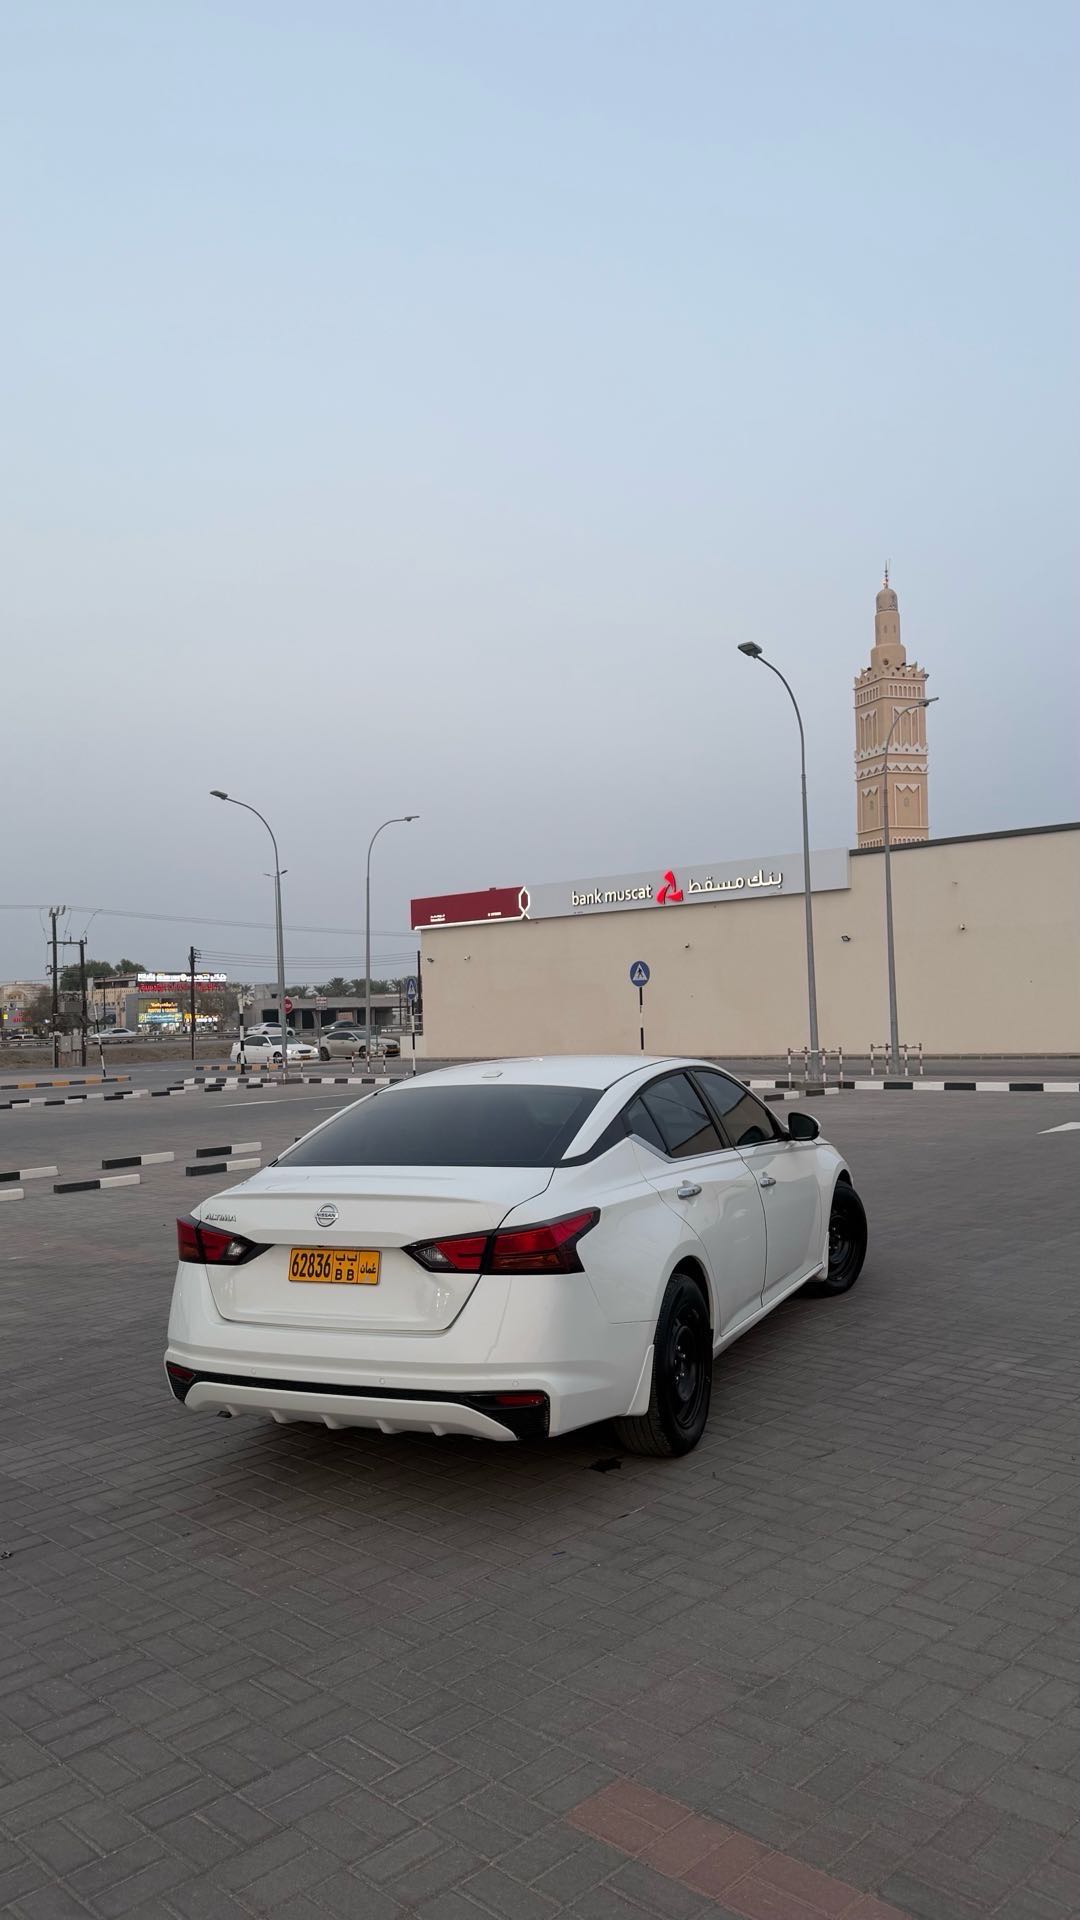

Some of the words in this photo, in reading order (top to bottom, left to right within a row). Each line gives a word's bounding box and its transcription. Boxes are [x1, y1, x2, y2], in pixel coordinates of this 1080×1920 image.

[687, 875, 744, 894] مسقط
[747, 869, 783, 888] بنك
[571, 889, 602, 906] bank
[604, 884, 652, 902] muscat
[291, 1253, 332, 1278] 62836
